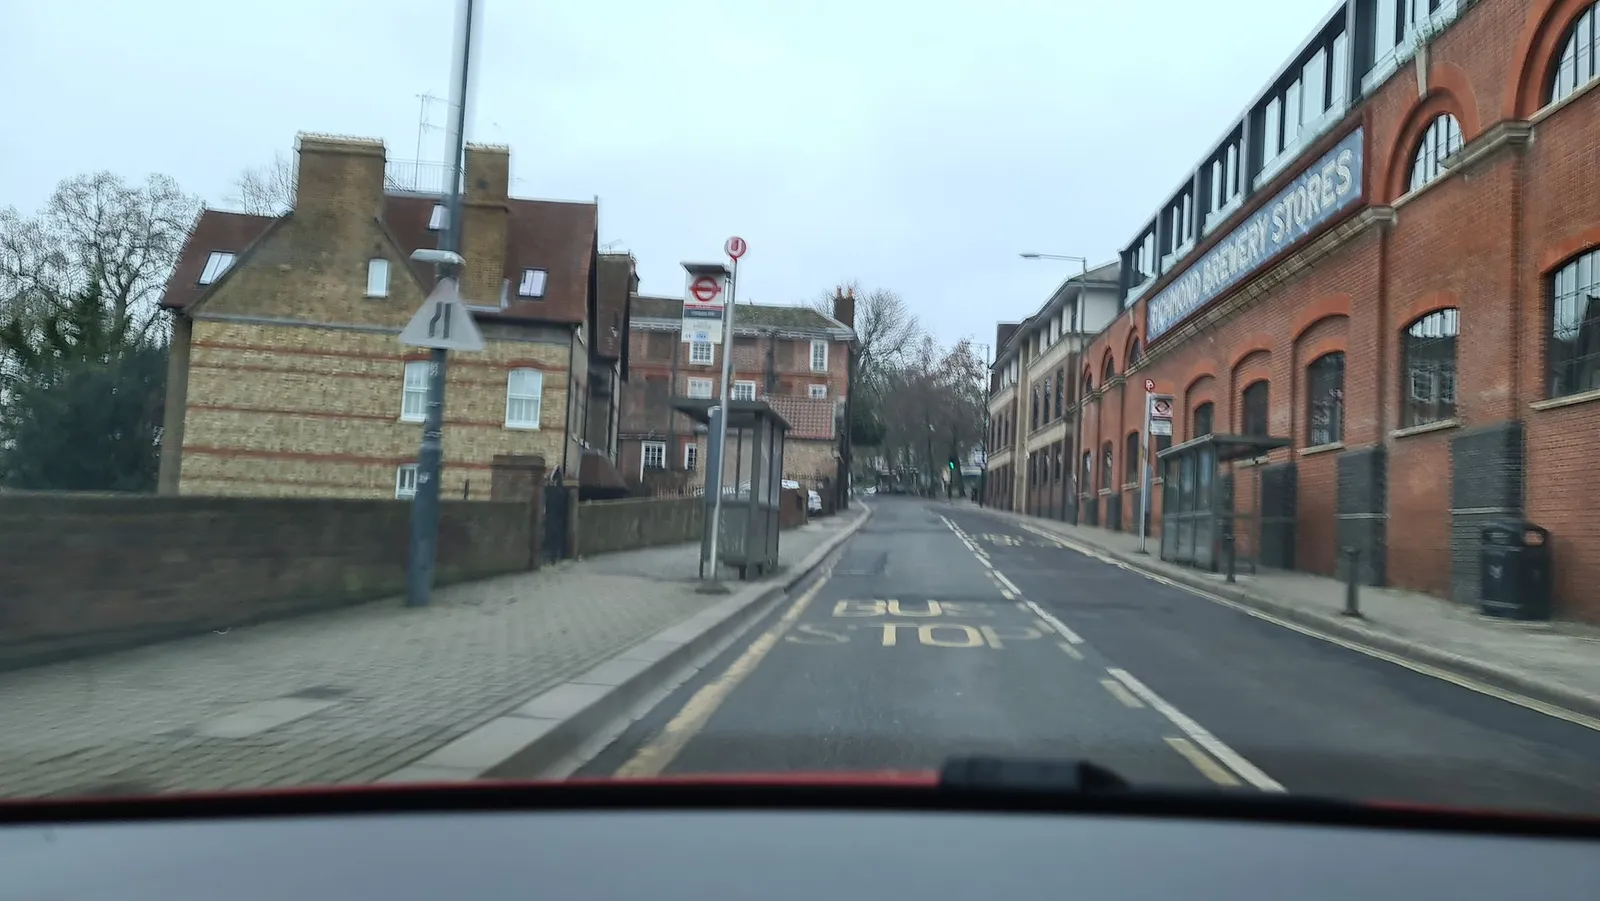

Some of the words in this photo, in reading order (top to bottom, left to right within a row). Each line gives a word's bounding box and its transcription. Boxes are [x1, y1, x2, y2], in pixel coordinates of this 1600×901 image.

[1150, 269, 1202, 333] RICHMOND
[1202, 213, 1269, 296] BREWERY
[1271, 148, 1354, 243] STORES
[832, 599, 997, 618] BUS
[785, 622, 1043, 650] STOP
